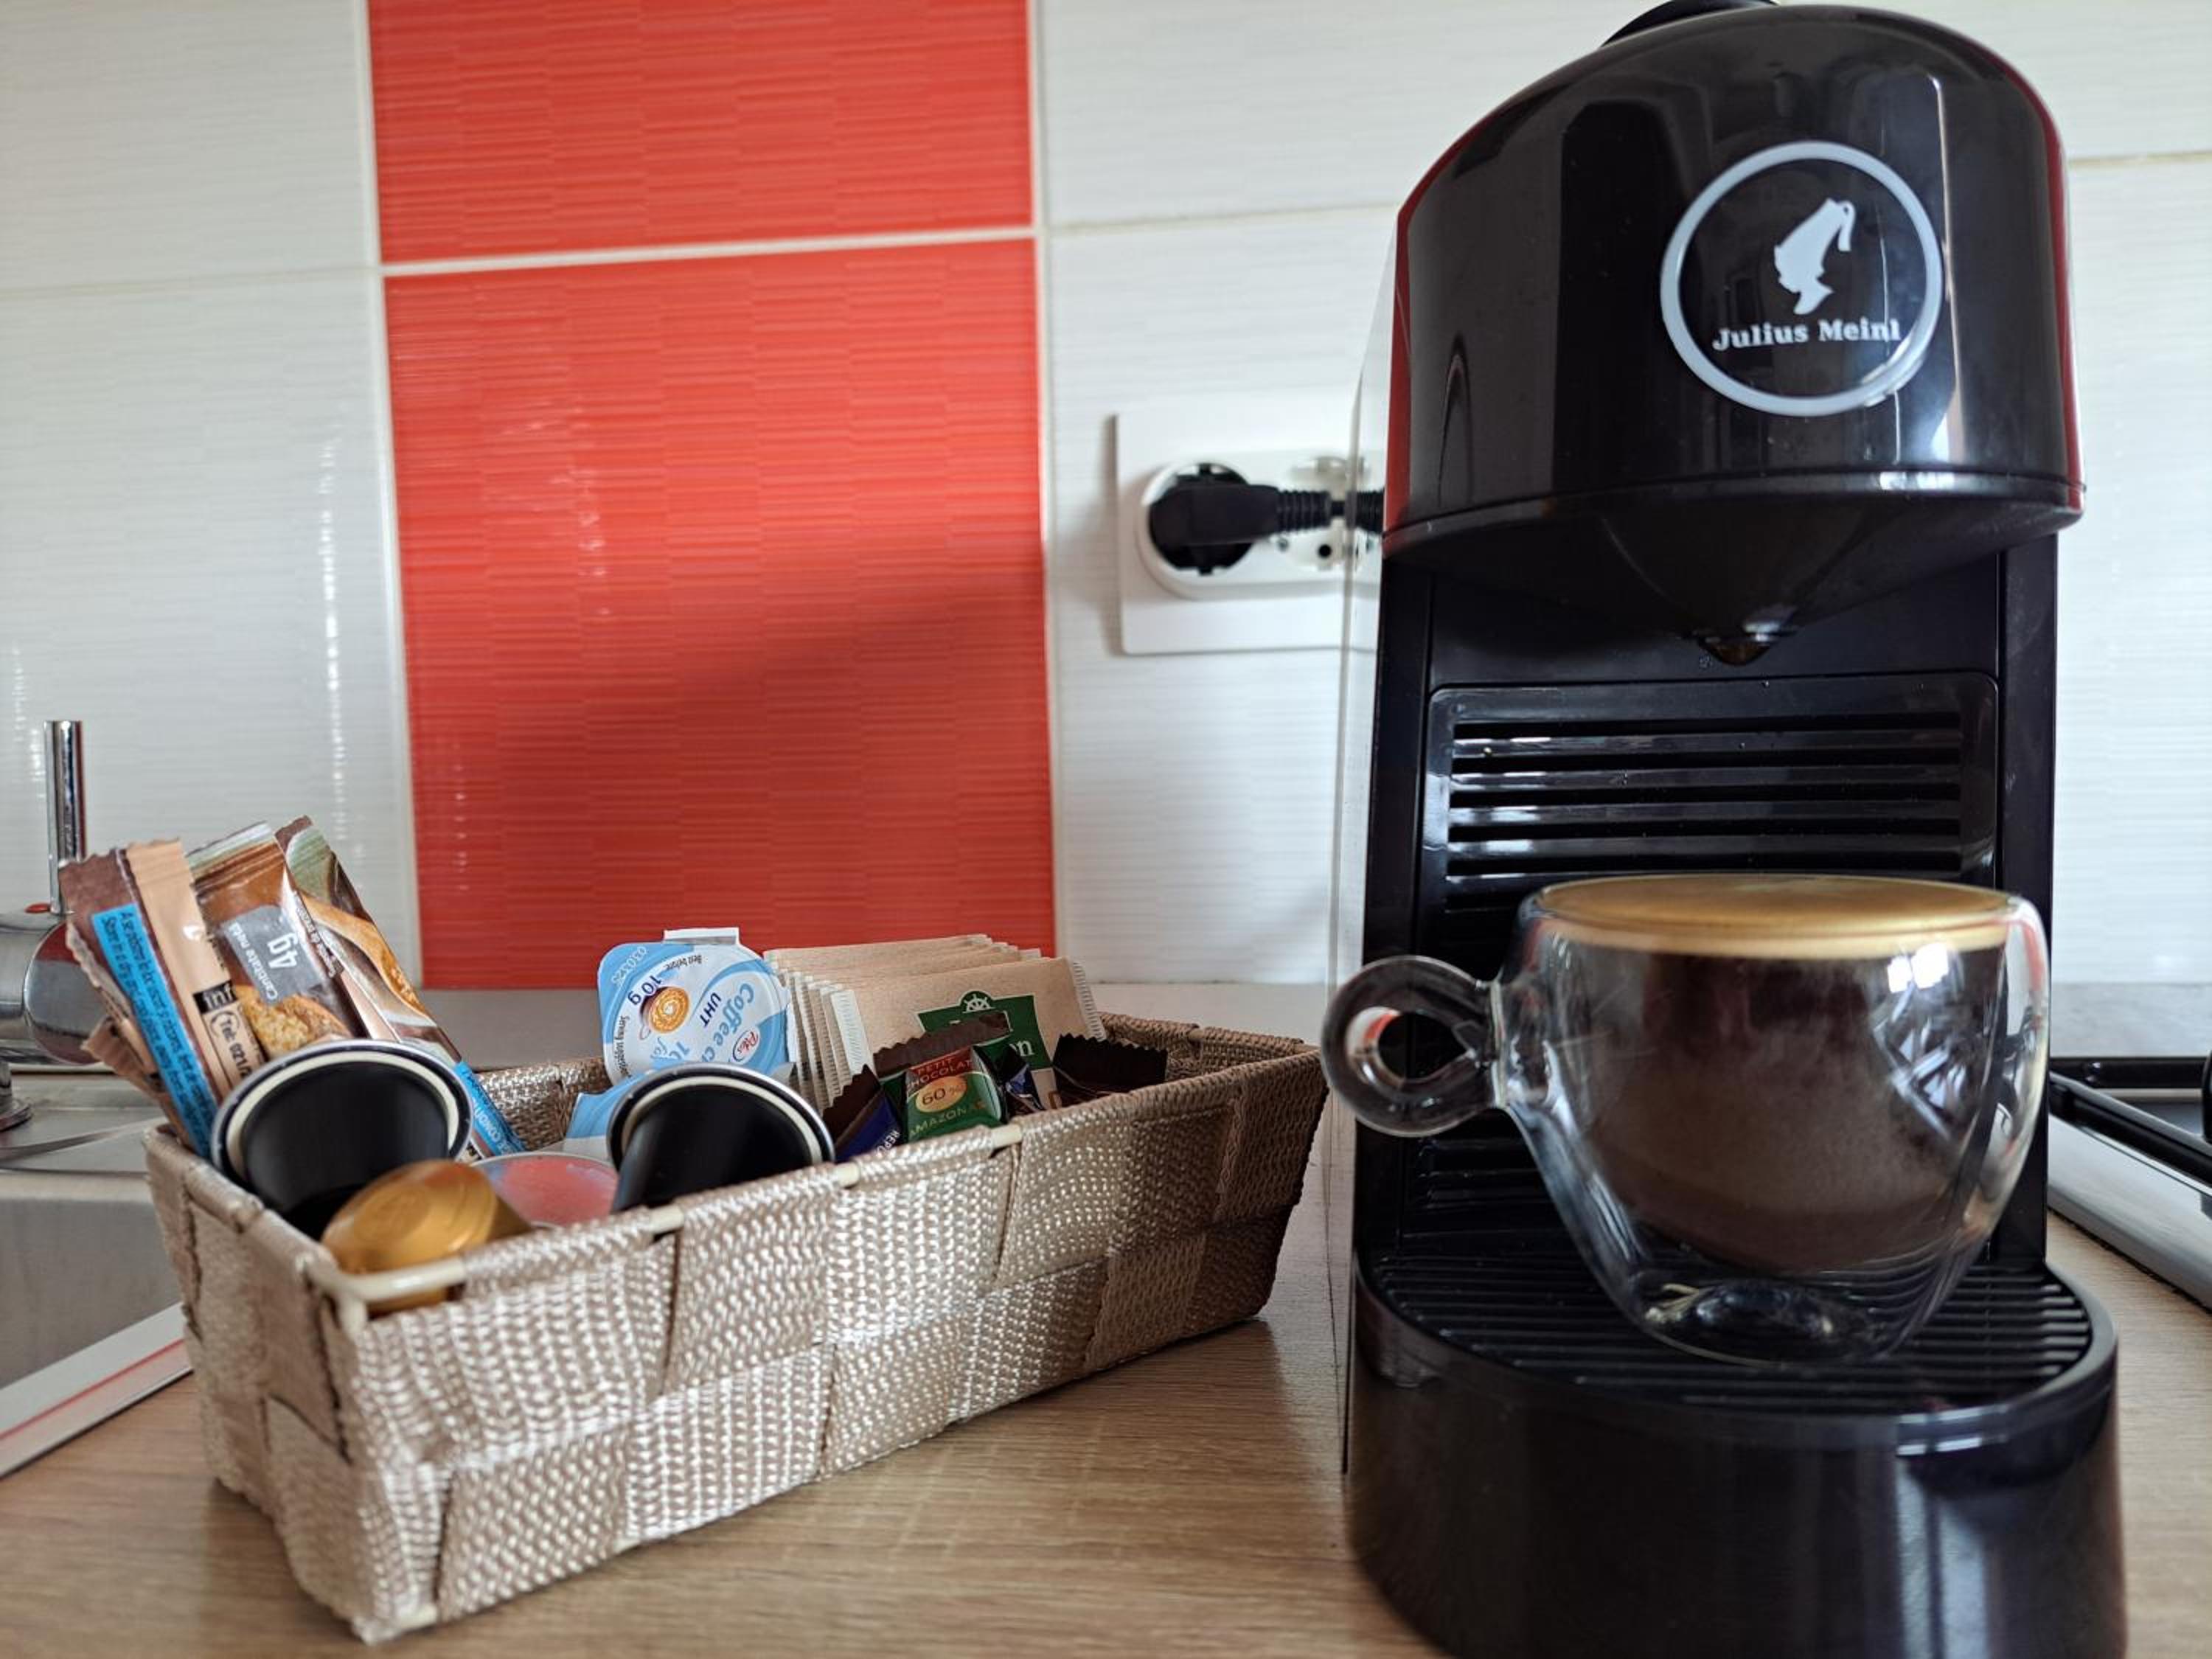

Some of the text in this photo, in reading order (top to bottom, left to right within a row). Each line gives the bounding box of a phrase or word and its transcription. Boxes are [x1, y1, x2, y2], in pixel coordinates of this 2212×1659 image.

[1711, 318, 1902, 352] Julius Meinl
[267, 932, 299, 969] 4g
[627, 975, 661, 1006] 10 g
[698, 992, 723, 1028] UHT
[712, 982, 755, 1046] Coffee
